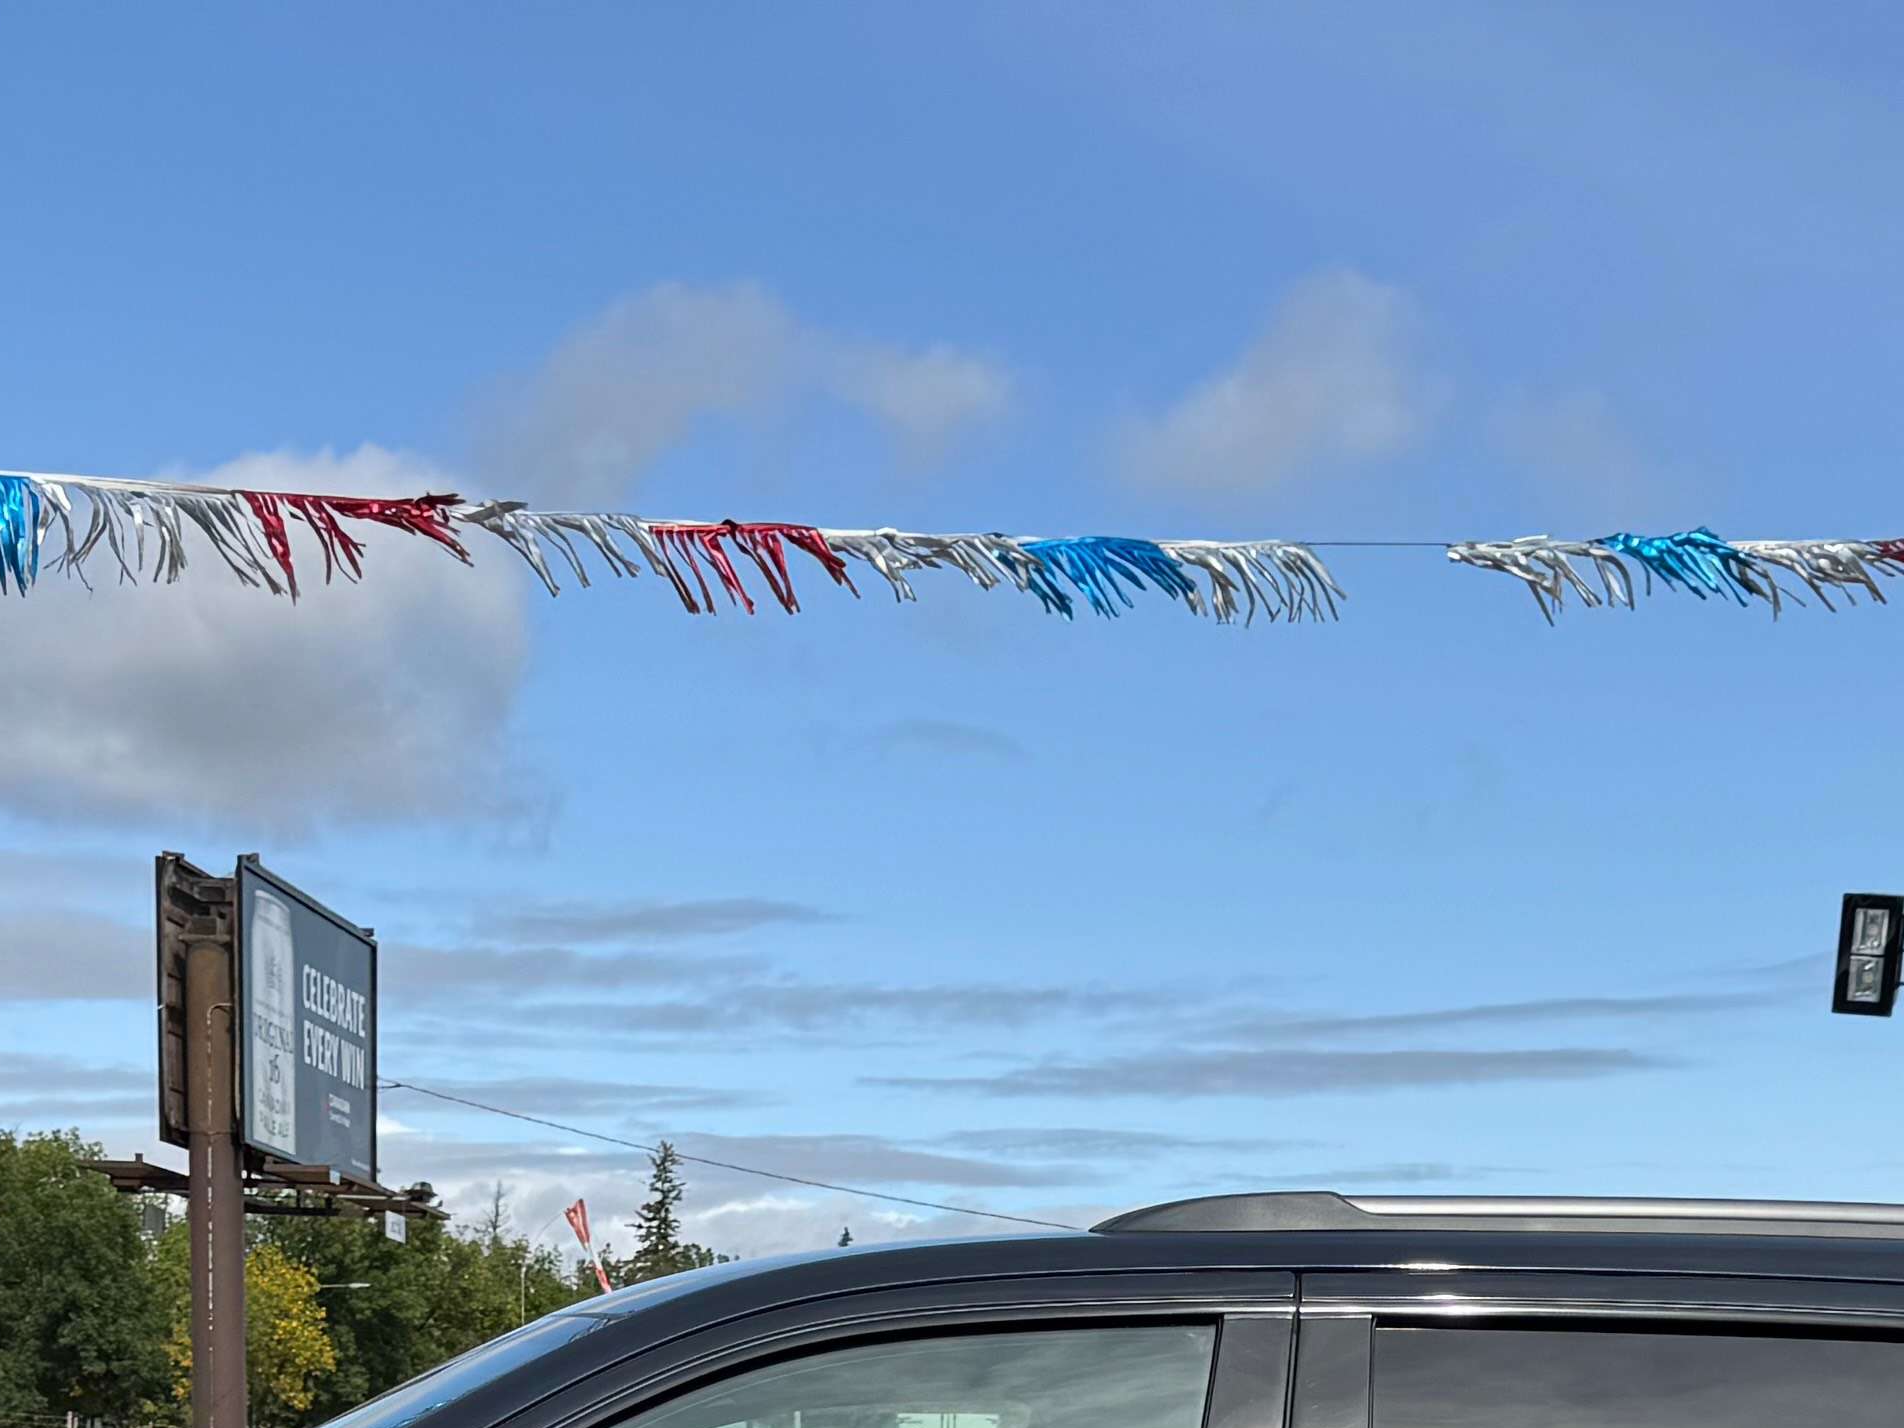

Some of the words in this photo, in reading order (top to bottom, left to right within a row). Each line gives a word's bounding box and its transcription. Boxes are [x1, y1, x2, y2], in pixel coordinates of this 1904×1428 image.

[302, 963, 366, 1037] CELEBRATE
[303, 1020, 338, 1078] EVERY
[338, 1040, 366, 1090] WIN
